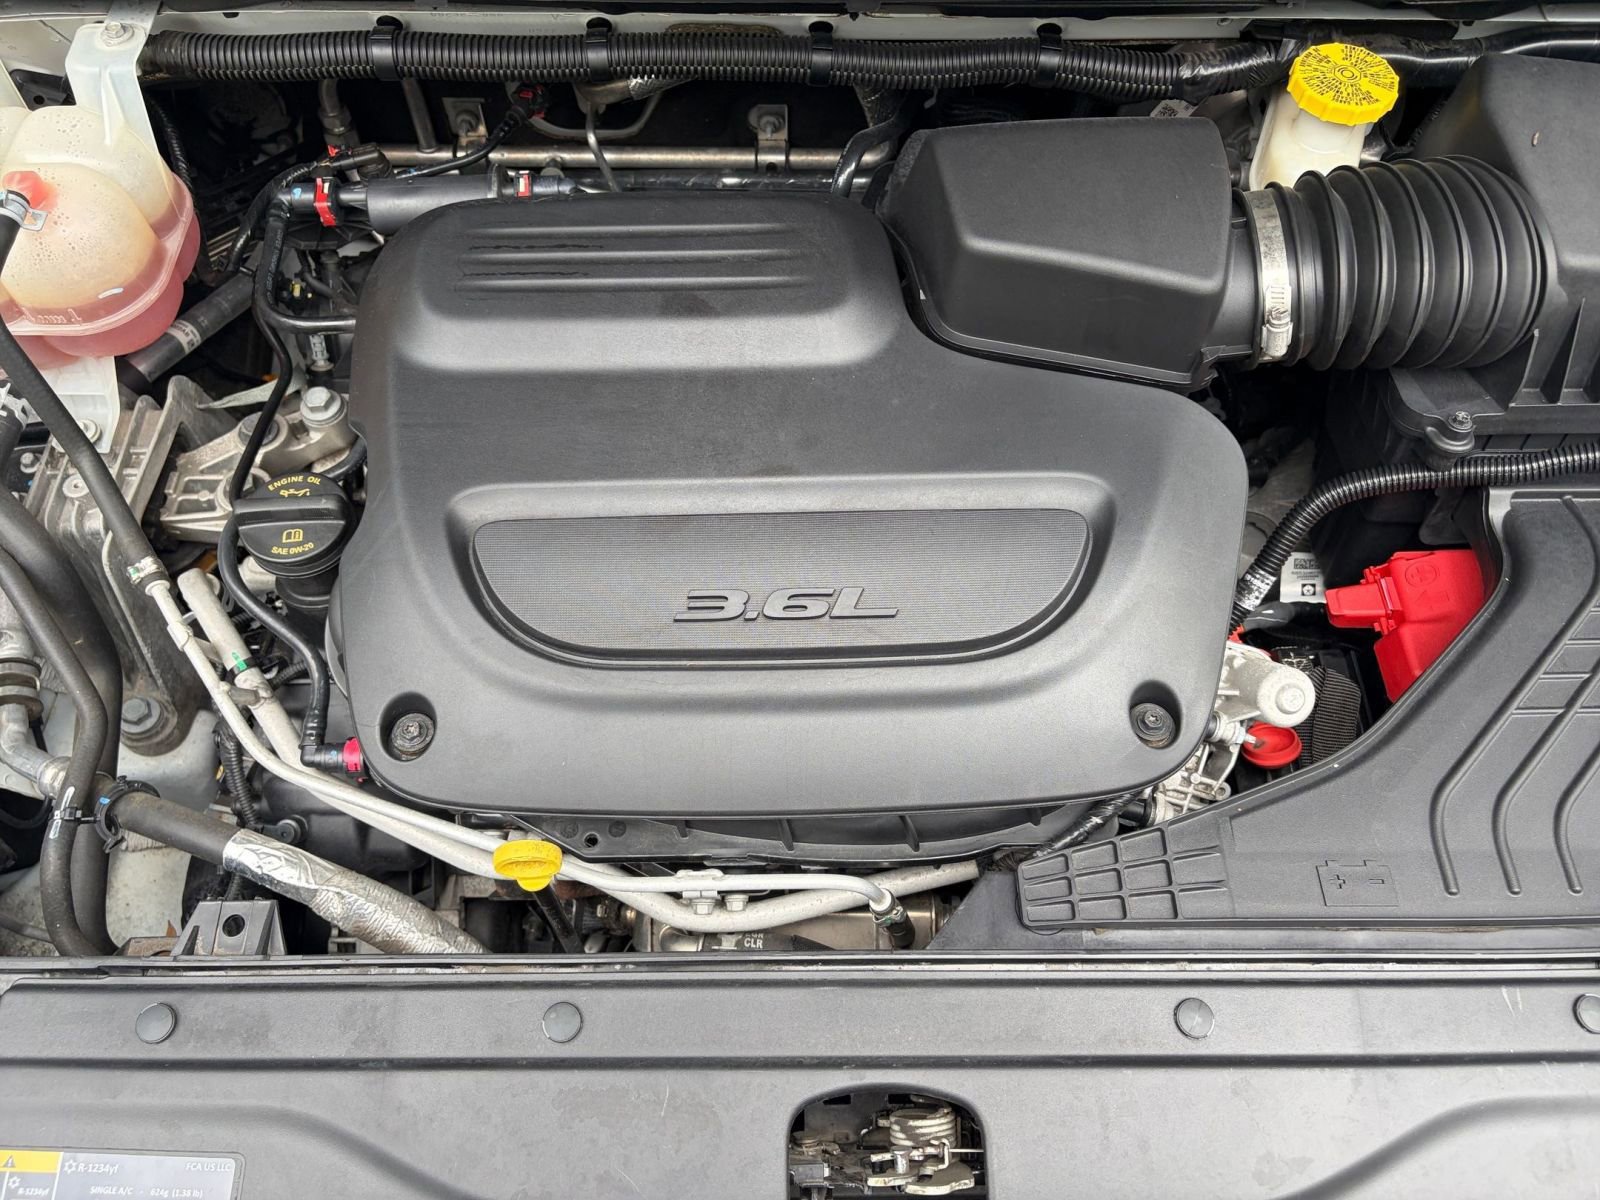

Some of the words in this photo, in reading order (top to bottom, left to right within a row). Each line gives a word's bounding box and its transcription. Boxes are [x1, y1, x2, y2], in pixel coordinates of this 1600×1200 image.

[267, 475, 304, 491] ENGINE
[307, 476, 321, 485] OIL
[271, 545, 289, 555] SAE
[289, 542, 315, 555] 0W-20
[673, 587, 899, 623] 3.6L
[744, 937, 763, 949] CLR
[77, 1162, 119, 1176] R-1234yf
[185, 1162, 203, 1171] FCA
[204, 1162, 216, 1172] US
[217, 1163, 231, 1172] LLC
[90, 1186, 117, 1195] SINGLE
[117, 1187, 134, 1196] A/C
